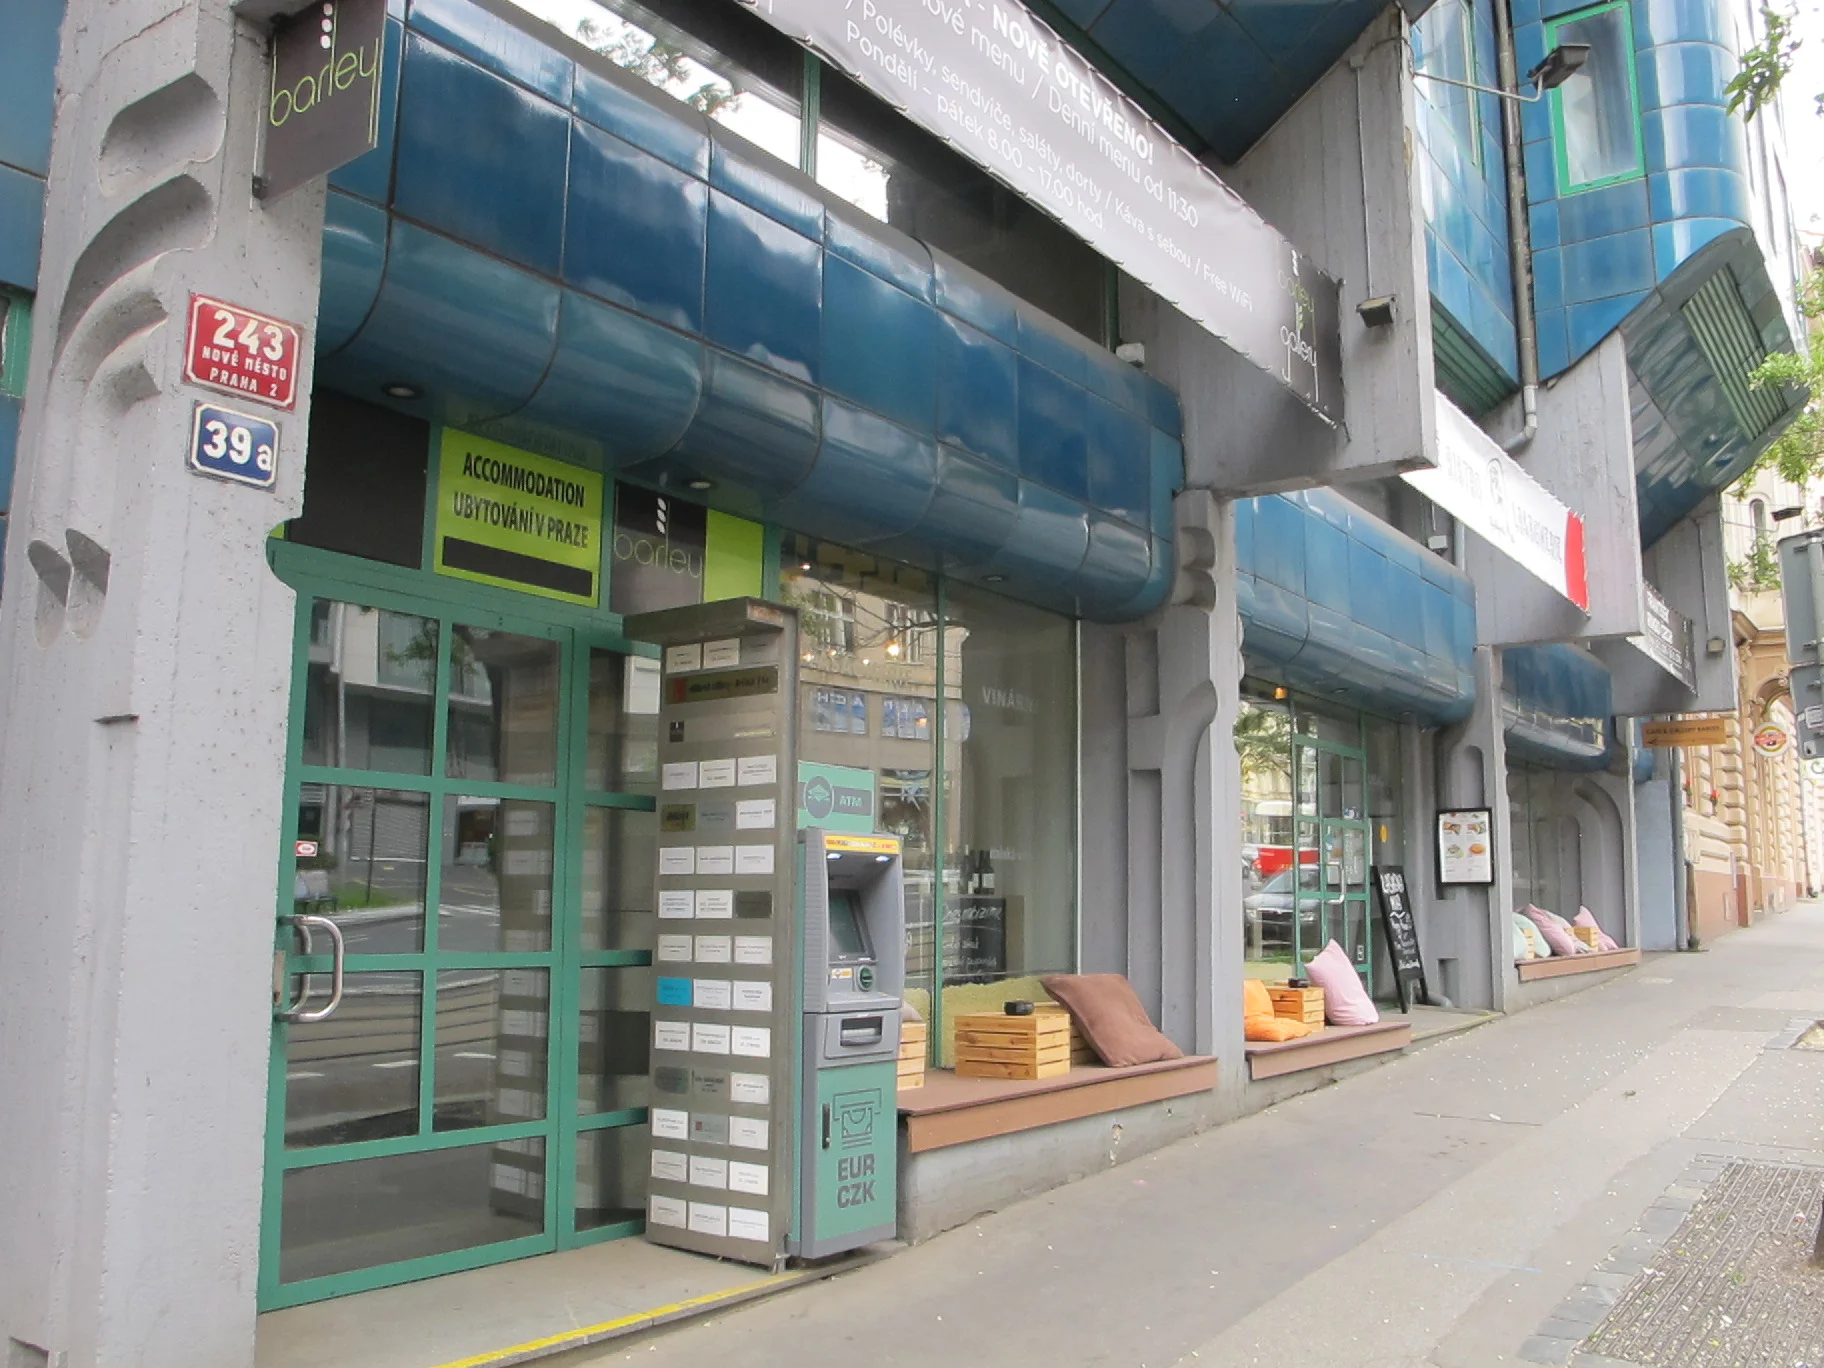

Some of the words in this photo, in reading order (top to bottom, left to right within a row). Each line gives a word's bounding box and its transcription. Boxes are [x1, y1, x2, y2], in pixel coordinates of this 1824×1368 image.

[270, 0, 380, 144] barley
[992, 7, 1049, 75] NOVĚ
[1055, 61, 1154, 166] OTEVŘENO!
[847, 19, 918, 91] Pondělí
[937, 93, 984, 140] pátek
[987, 127, 1023, 169] 8.00
[1037, 165, 1074, 208] 17.00
[1076, 193, 1106, 232] hod.
[971, 27, 1025, 86] menu
[1049, 85, 1095, 145] Denní
[1099, 135, 1141, 183] menu
[1144, 173, 1163, 203] od
[863, 1, 937, 75] Polévky,
[941, 64, 1016, 137] sendviče,
[1019, 126, 1063, 173] saláty,
[1066, 162, 1101, 204] dorty
[1115, 197, 1145, 235] Káva
[1156, 232, 1192, 269] sebou
[1203, 263, 1228, 296] Free
[213, 309, 284, 361] 243
[209, 367, 258, 393] PRAHA
[269, 384, 279, 397] 2
[463, 452, 585, 508] ACCOMMODATION
[453, 491, 535, 535] UBYTOVÁNÍ
[535, 514, 545, 537] V
[547, 517, 590, 549] PRAZE
[839, 795, 863, 808] ATM
[837, 1153, 876, 1182] EUR
[837, 1180, 877, 1209] CZK
